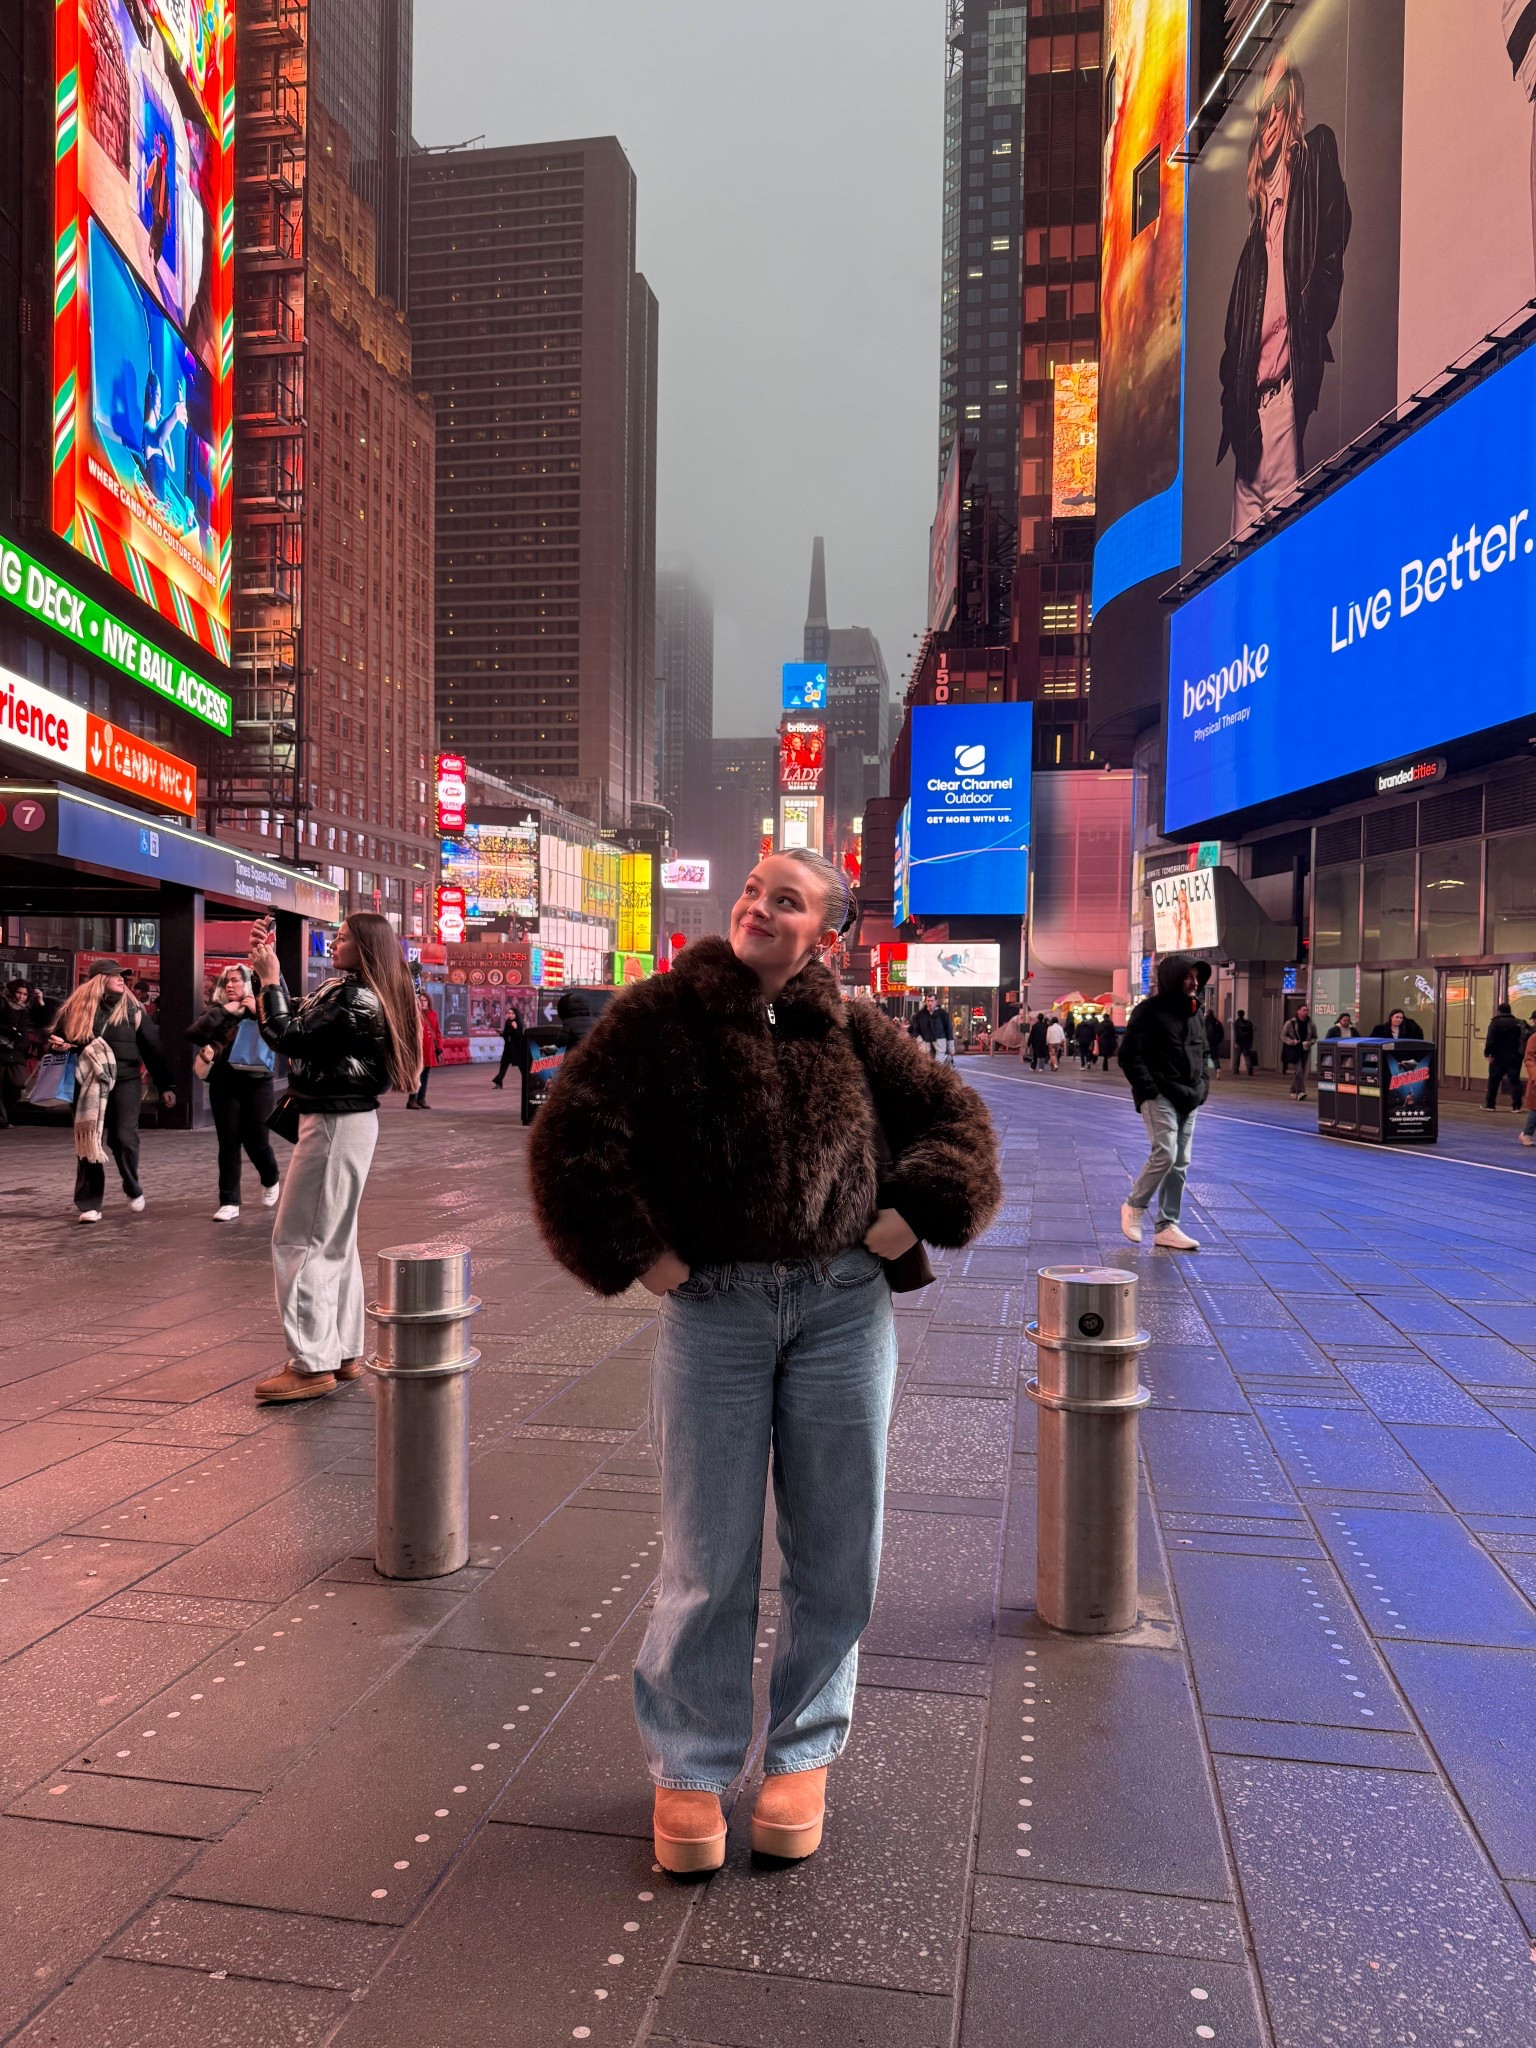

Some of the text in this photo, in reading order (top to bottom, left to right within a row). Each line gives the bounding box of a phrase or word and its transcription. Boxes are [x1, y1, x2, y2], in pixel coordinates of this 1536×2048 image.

[88, 455, 216, 588] WHERE CANDY AND CULTURE COLLIDE
[1331, 508, 1534, 654] Live Better.
[0, 544, 228, 728] G DECK NYE BALL ACCESS
[935, 652, 949, 705] 150
[1182, 643, 1270, 720] bespoke
[787, 722, 819, 733] britbox
[1193, 705, 1251, 742] Physical Therapy
[160, 762, 182, 798] NYC
[782, 767, 824, 781] LADY
[927, 777, 1013, 792] Clear Channel
[785, 800, 818, 808] SAMSUNG
[945, 792, 994, 805] Outdoor
[22, 806, 36, 825] 7
[926, 815, 1013, 824] GET MORE WITH US.
[235, 860, 251, 878] Times
[235, 879, 272, 902] Subway Station
[494, 951, 527, 961] FORCES
[1314, 1004, 1337, 1015] RETAIL
